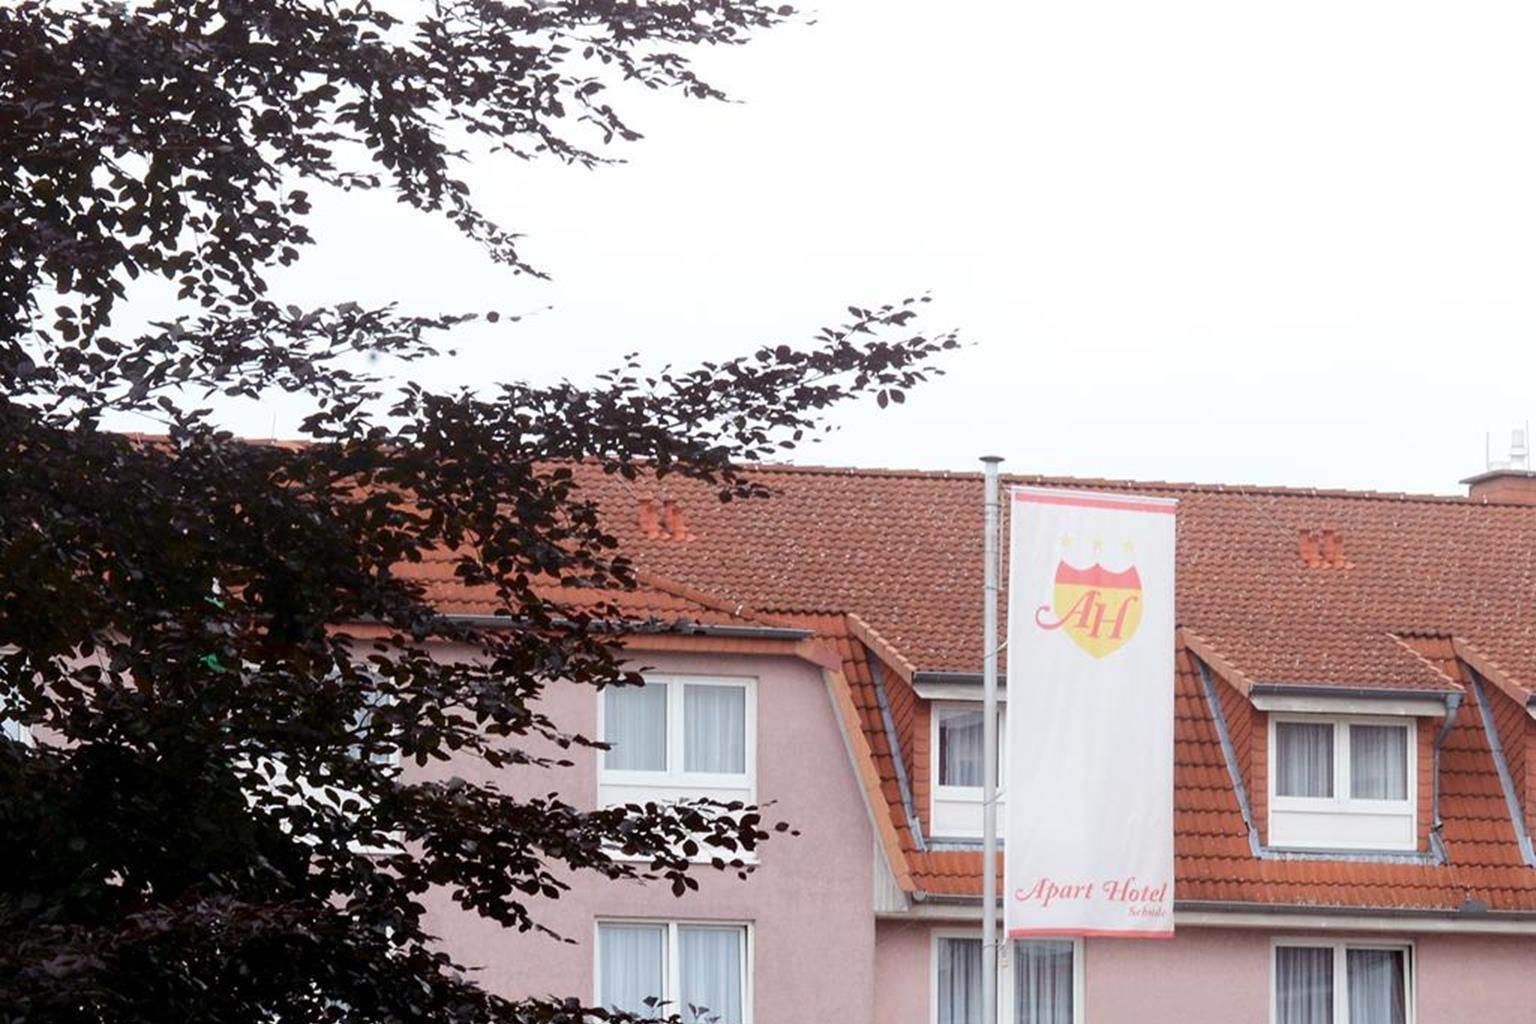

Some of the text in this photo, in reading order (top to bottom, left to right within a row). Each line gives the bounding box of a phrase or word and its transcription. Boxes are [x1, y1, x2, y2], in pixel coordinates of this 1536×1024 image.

[1034, 589, 1139, 641] AH
[1015, 876, 1168, 907] Apart Hotel
